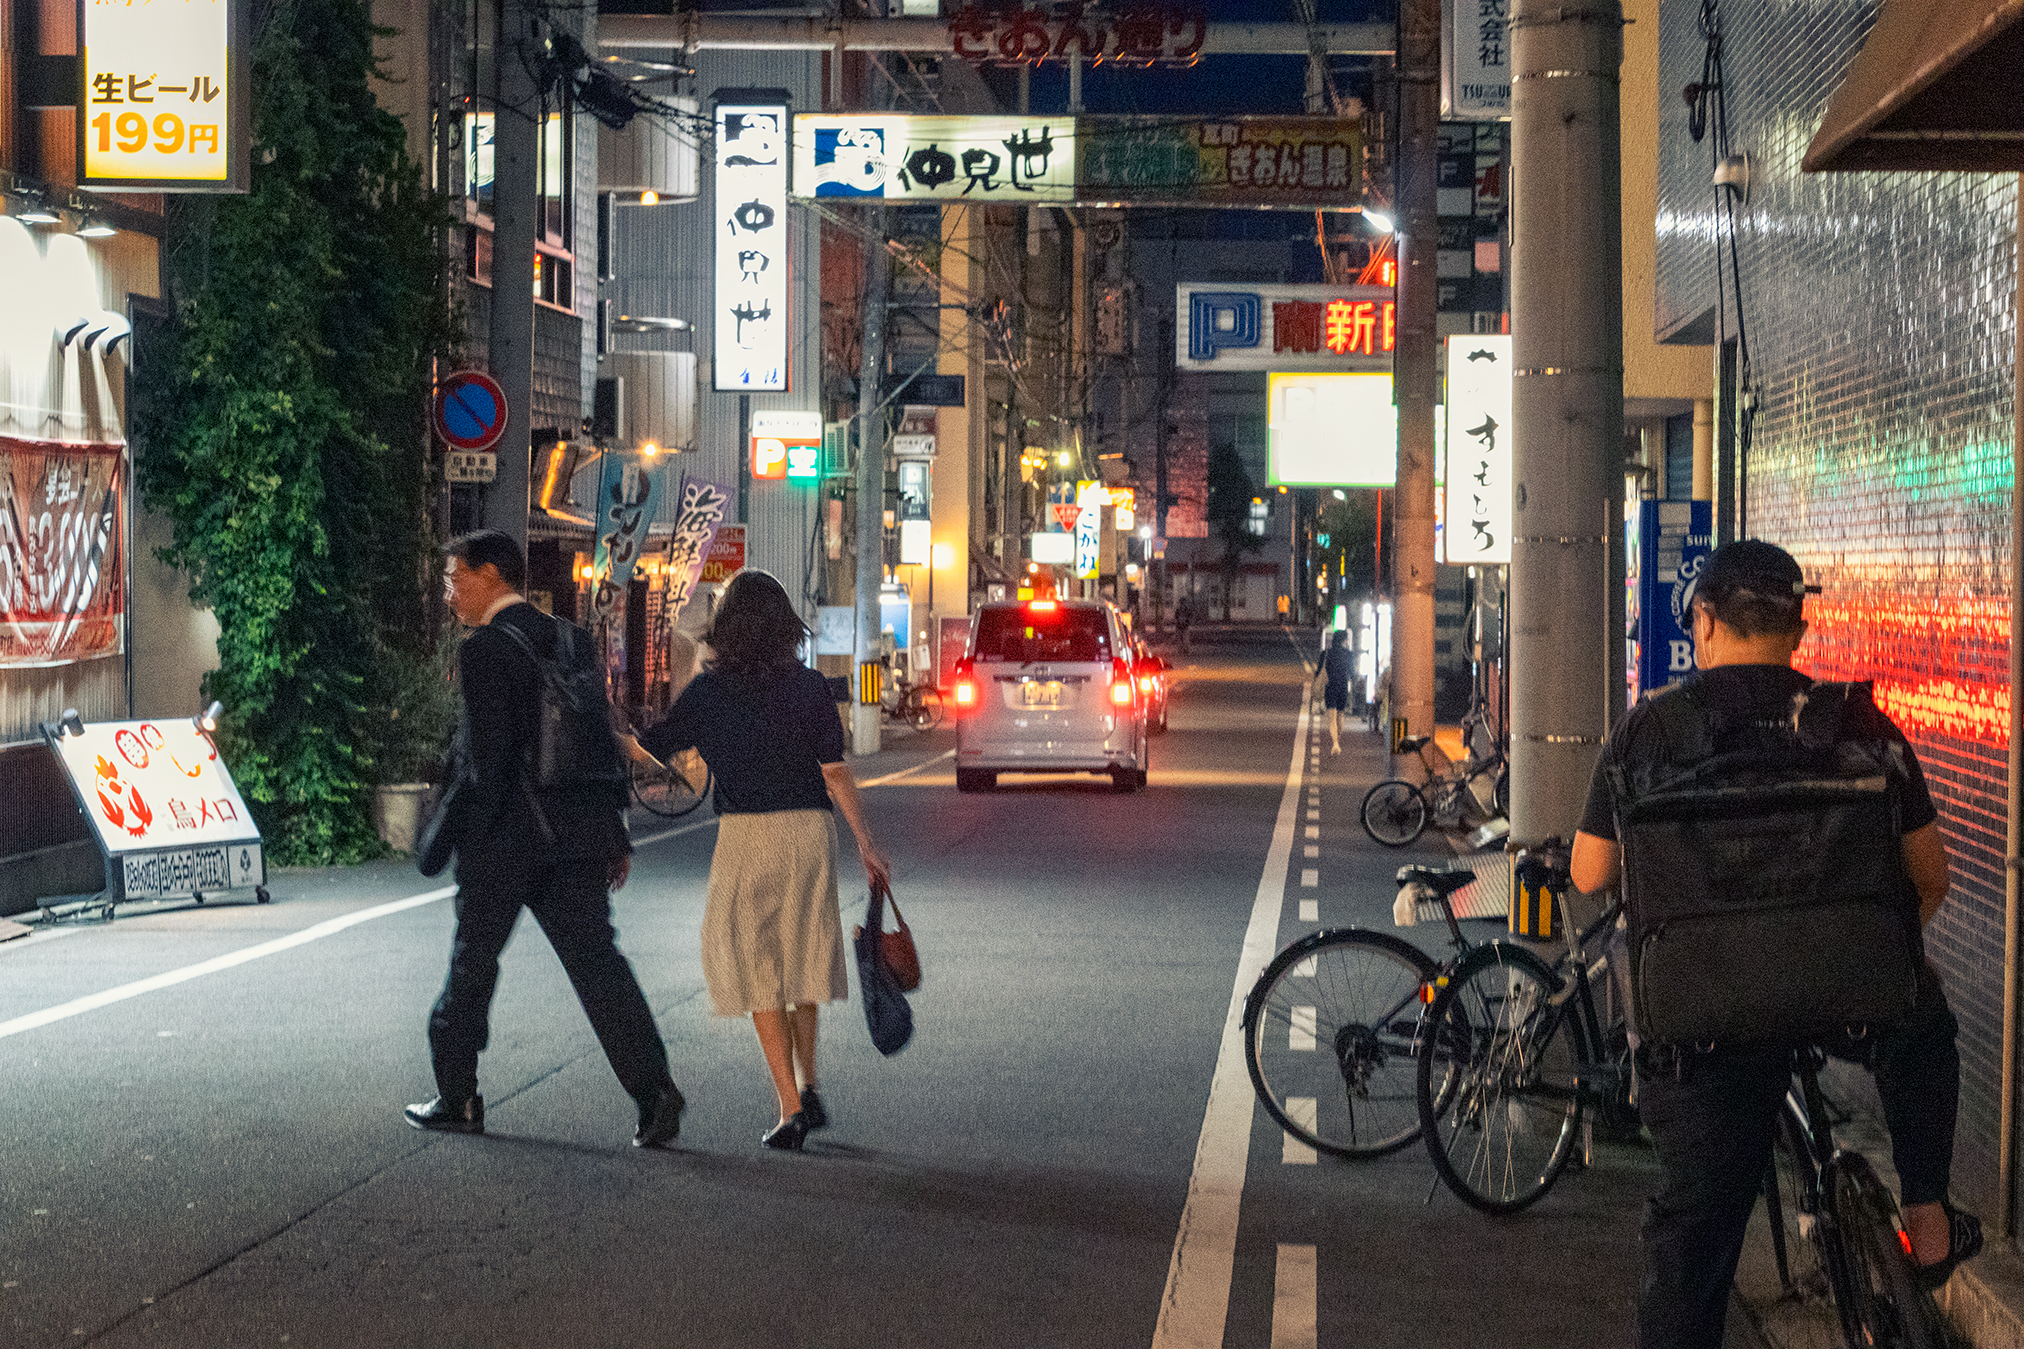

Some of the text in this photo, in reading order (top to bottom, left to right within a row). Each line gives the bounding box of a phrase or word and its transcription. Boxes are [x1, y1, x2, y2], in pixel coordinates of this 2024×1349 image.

[92, 72, 220, 104] 生ビール
[92, 111, 219, 154] 199円
[897, 125, 1055, 195] 仲見世
[1226, 142, 1350, 187] ぎおん温泉
[756, 438, 786, 476] P
[168, 797, 238, 830] 鳥メロ
